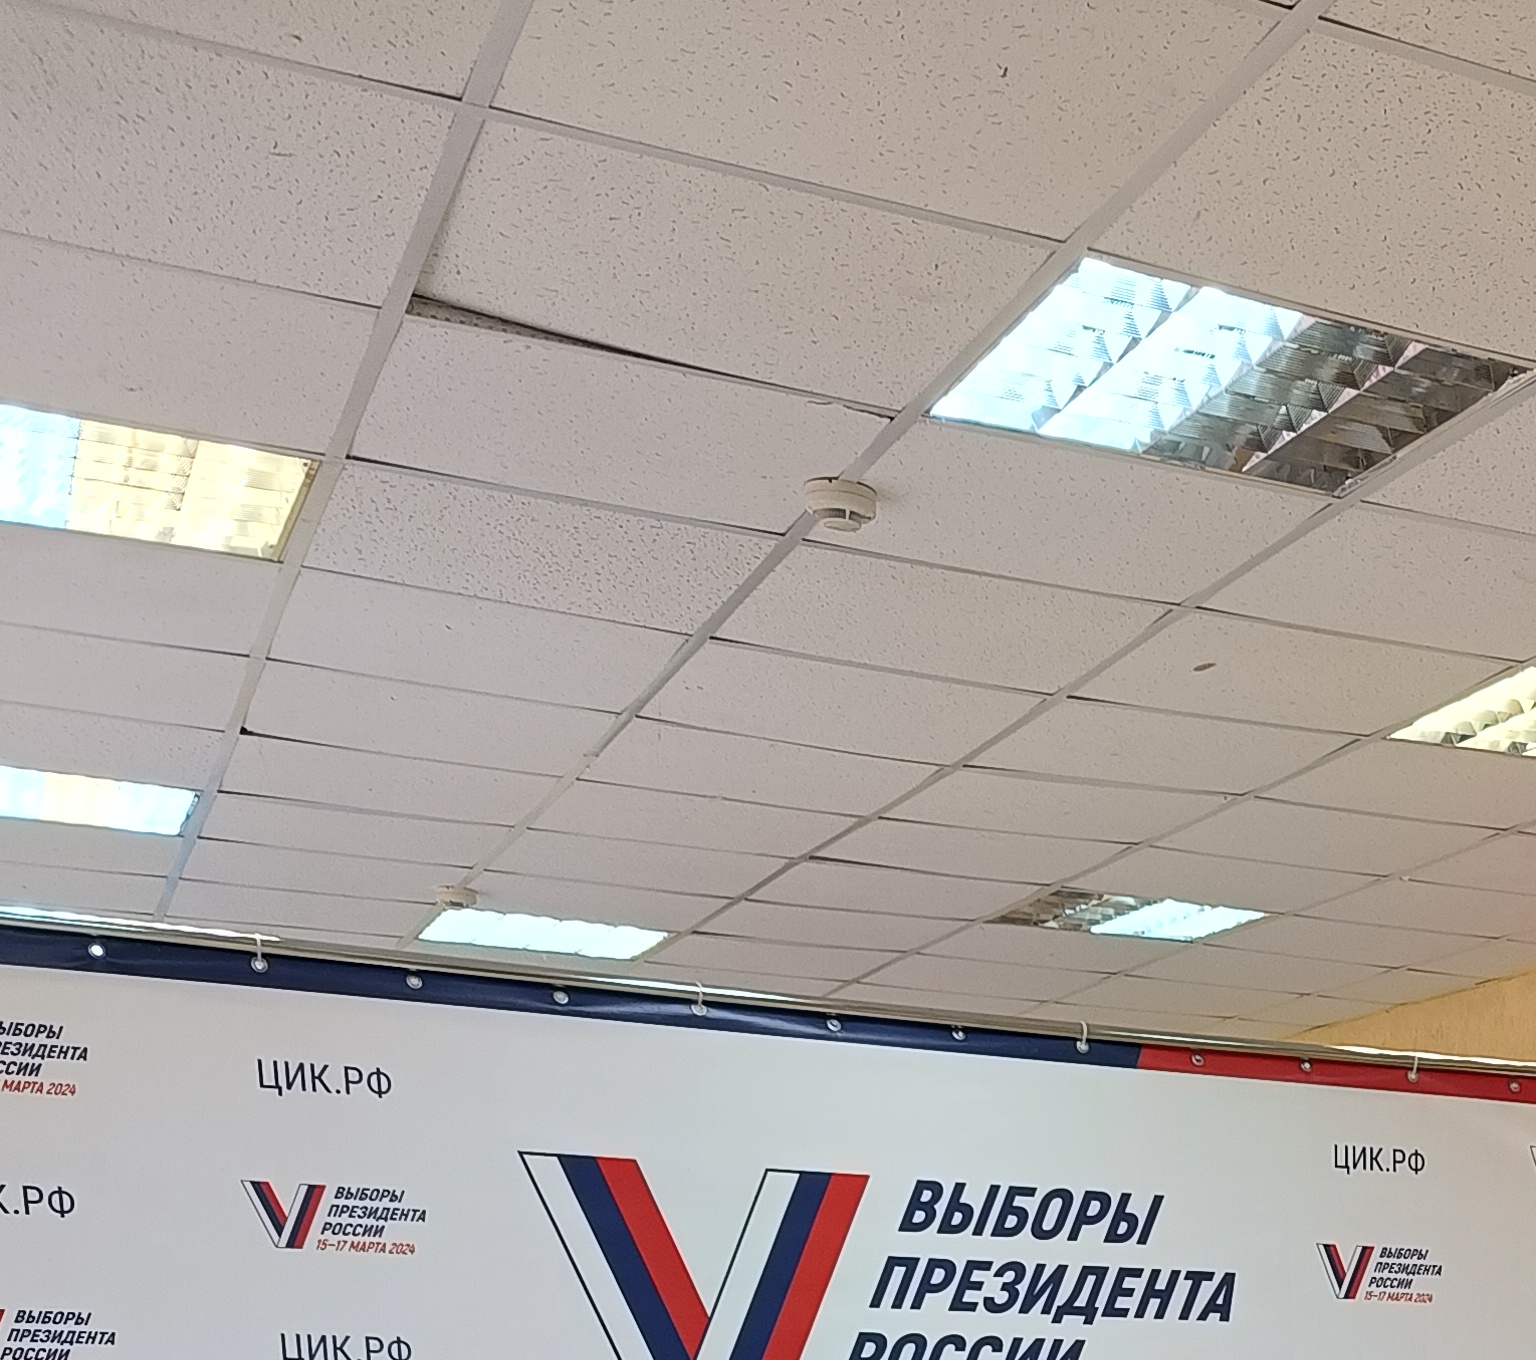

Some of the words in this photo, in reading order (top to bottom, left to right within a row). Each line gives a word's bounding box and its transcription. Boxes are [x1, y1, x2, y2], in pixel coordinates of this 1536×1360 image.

[0, 1020, 63, 1039] ЫБОРЫ
[0, 1040, 88, 1061] ЕЗИДЕНТА
[0, 1059, 42, 1077] ССИИ
[257, 1059, 391, 1098] ЦИК.РФ
[1, 1080, 44, 1094] МАРТА
[46, 1083, 76, 1096] 2024
[1334, 1144, 1425, 1175] ЦИК.РФ
[334, 1186, 405, 1203] ВЫБОРЫ
[327, 1204, 426, 1222] ПРЕЗИДЕНТА
[898, 1179, 1164, 1245] ВЫБОРЫ
[320, 1222, 385, 1238] РОССИИ
[348, 1241, 386, 1253] МАРТА
[388, 1243, 415, 1255] 2024
[1379, 1247, 1428, 1260] ВЫБОРЫ
[1373, 1262, 1442, 1276] ПРЕЗИДЕНТА
[869, 1256, 1237, 1324] ПРЕЗИДЕНТА
[1368, 1277, 1413, 1289] РОССИИ
[14, 1310, 91, 1325] ВЫБОРЫ
[7, 1329, 115, 1345] ПРЕЗИДЕНТА
